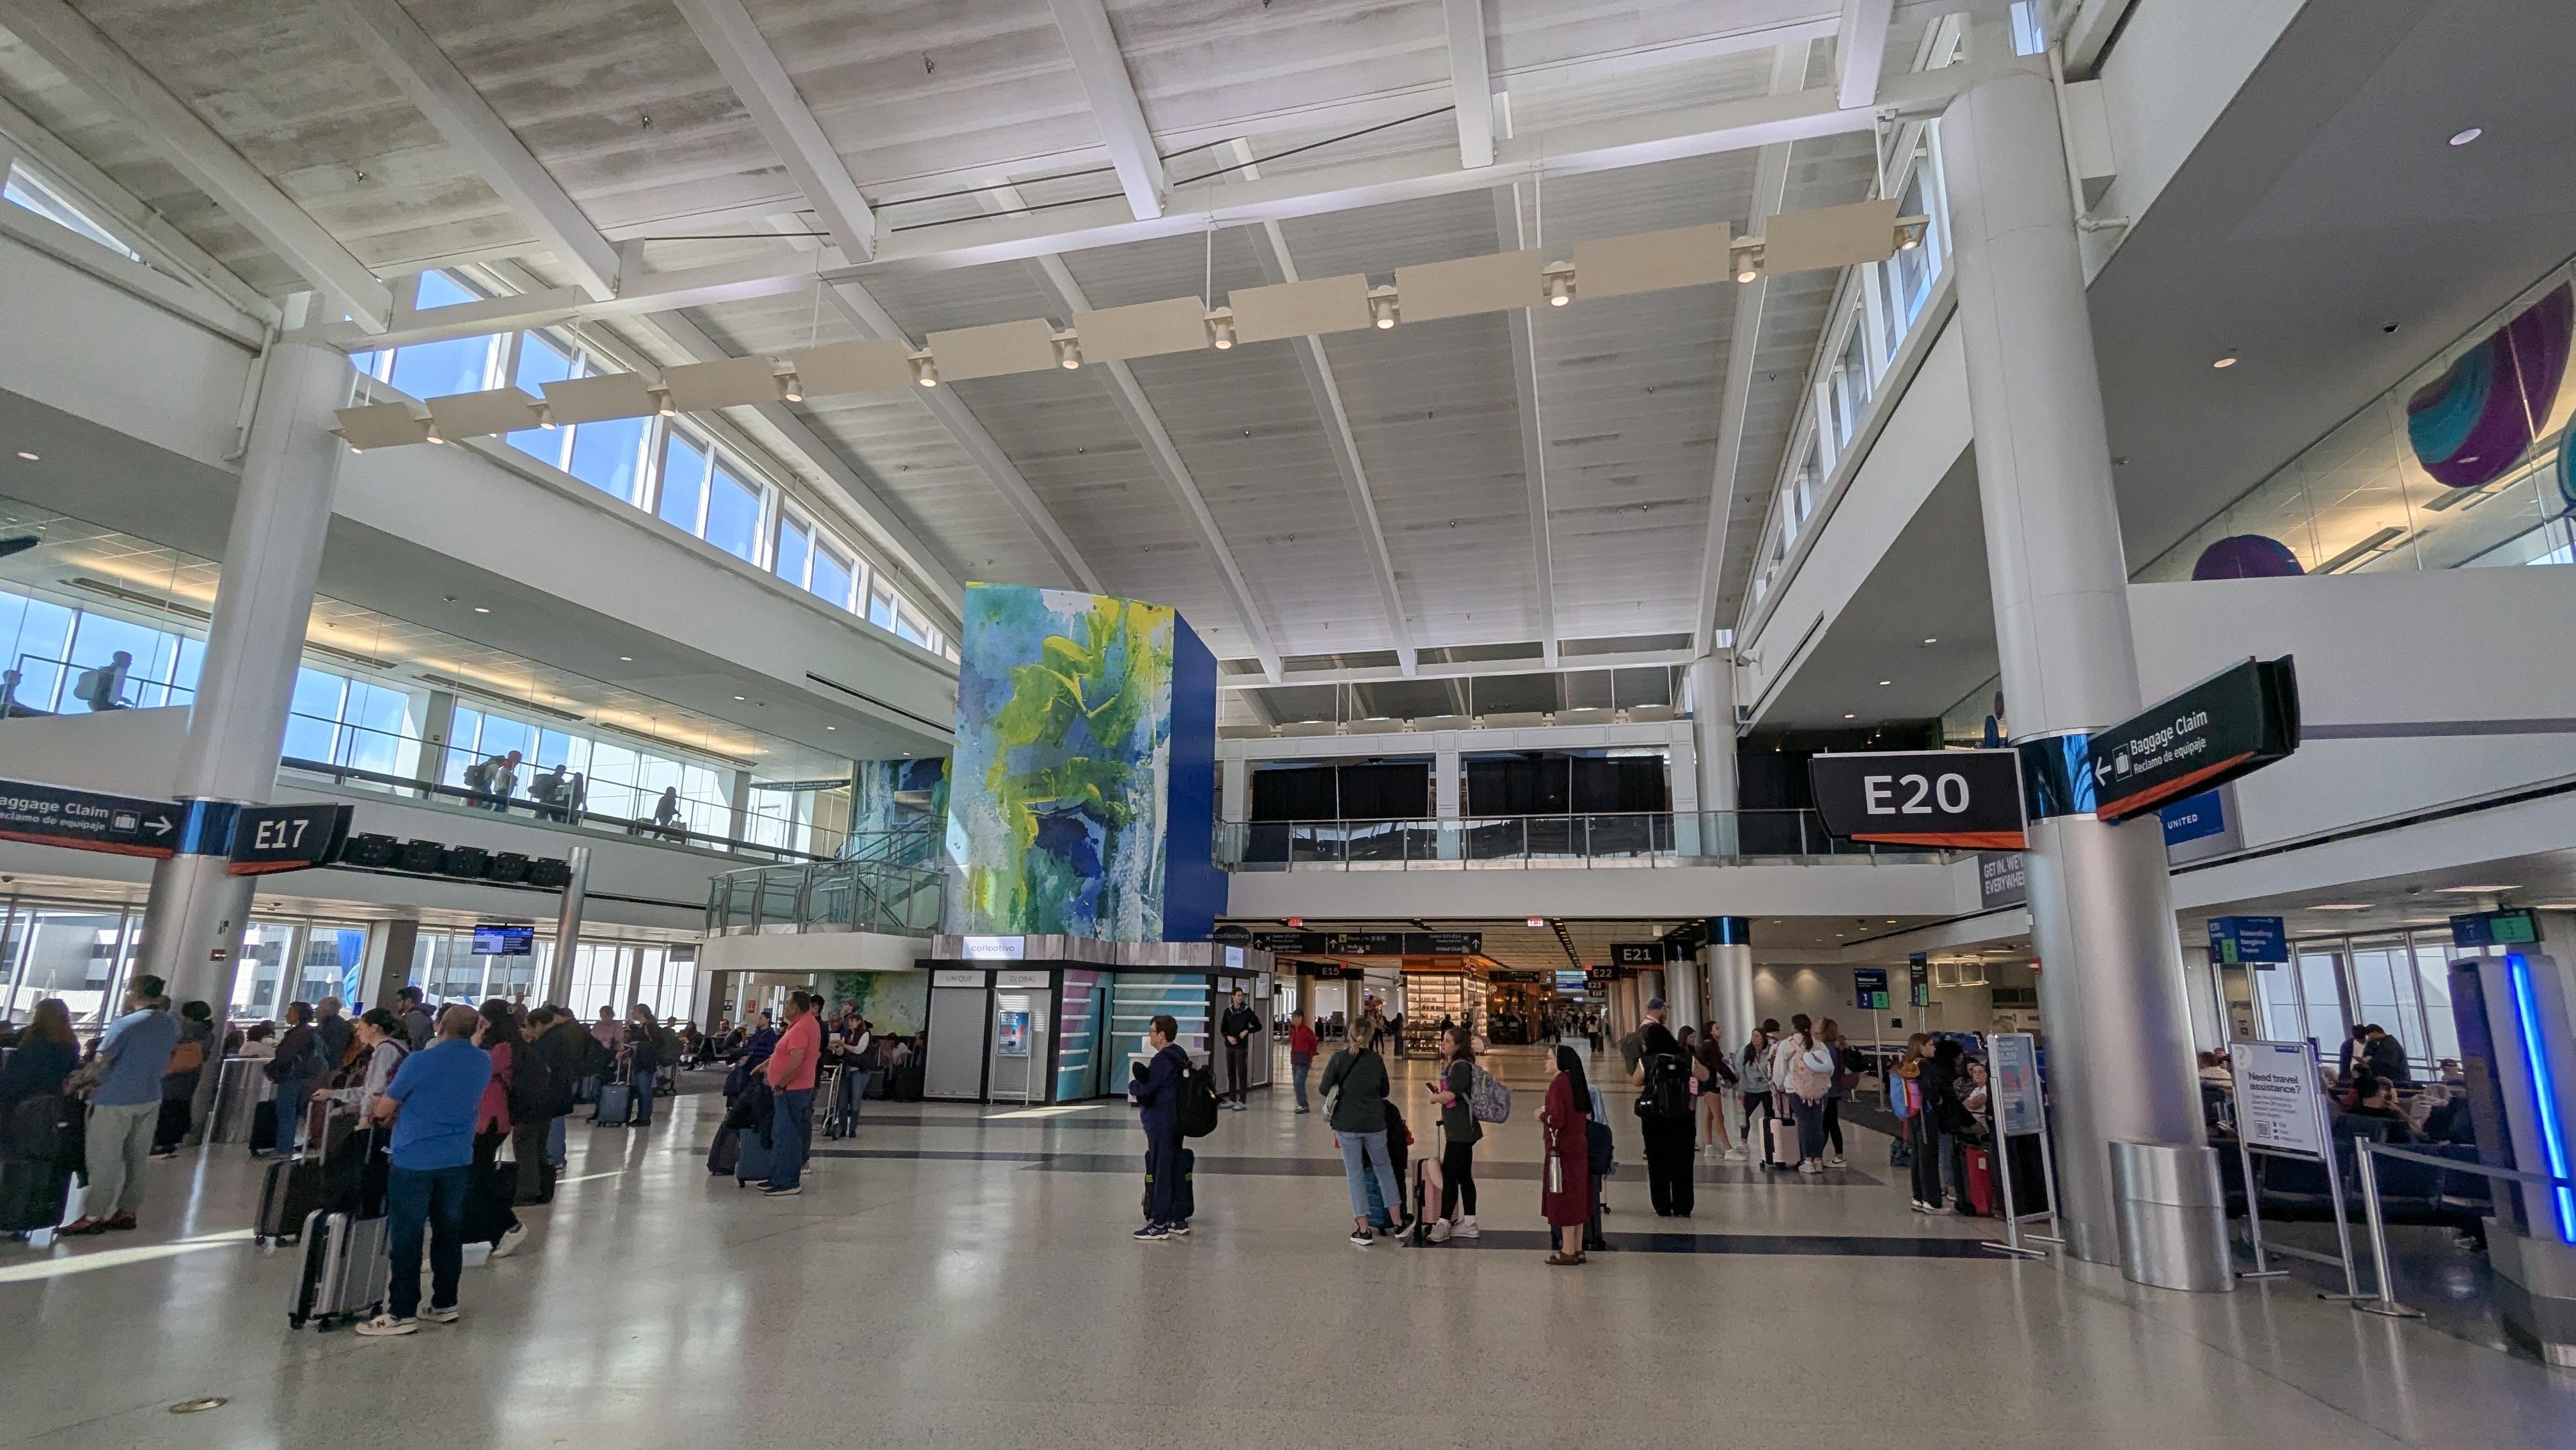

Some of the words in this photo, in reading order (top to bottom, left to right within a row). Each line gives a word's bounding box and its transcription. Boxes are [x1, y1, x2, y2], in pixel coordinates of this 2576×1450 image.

[2130, 726, 2174, 756] Baggage
[2176, 711, 2208, 735] Claim
[2133, 756, 2163, 774] Reclamo
[2163, 750, 2174, 763] de
[2174, 737, 2206, 759] equipaje
[1864, 773, 1970, 815] E20
[0, 796, 60, 812] aggage
[65, 802, 109, 818] Claim
[0, 811, 40, 823] eclamo
[42, 815, 58, 825] de
[59, 818, 106, 832] equipaje
[2167, 814, 2198, 830] UNITED
[255, 819, 309, 849] E17
[1984, 861, 1996, 878] GET
[1996, 859, 2007, 875] IN.
[1623, 948, 1652, 960] E21
[1322, 967, 1340, 976] E15
[1593, 968, 1613, 978] E22
[2248, 1072, 2272, 1082] Need
[2273, 1076, 2299, 1084] travel
[2249, 1084, 2301, 1094] assistance?
